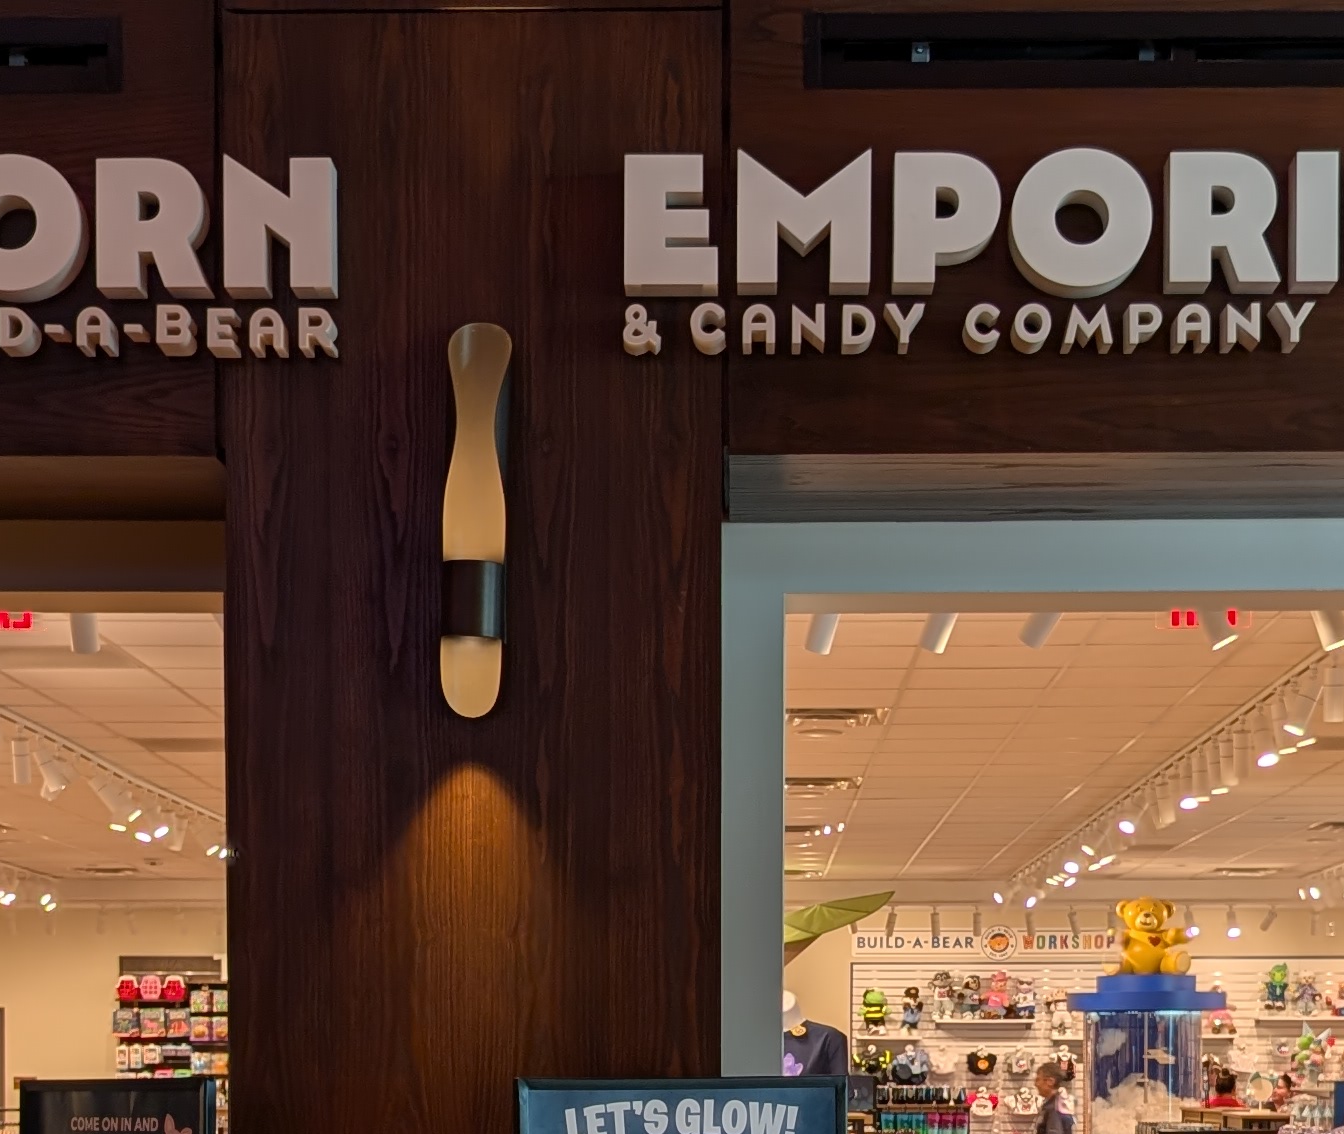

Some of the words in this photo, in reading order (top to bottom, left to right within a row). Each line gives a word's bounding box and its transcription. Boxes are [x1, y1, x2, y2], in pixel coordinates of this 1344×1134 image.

[621, 305, 662, 358] &
[688, 302, 926, 357] CANDY
[962, 302, 1317, 357] COMPANY
[856, 935, 974, 949] BUILD-A-BEAR
[1022, 933, 1116, 950] WORKSHOP
[70, 1116, 100, 1132] COME
[101, 1117, 119, 1132] ON
[121, 1117, 132, 1132] IN
[134, 1117, 159, 1132] AND
